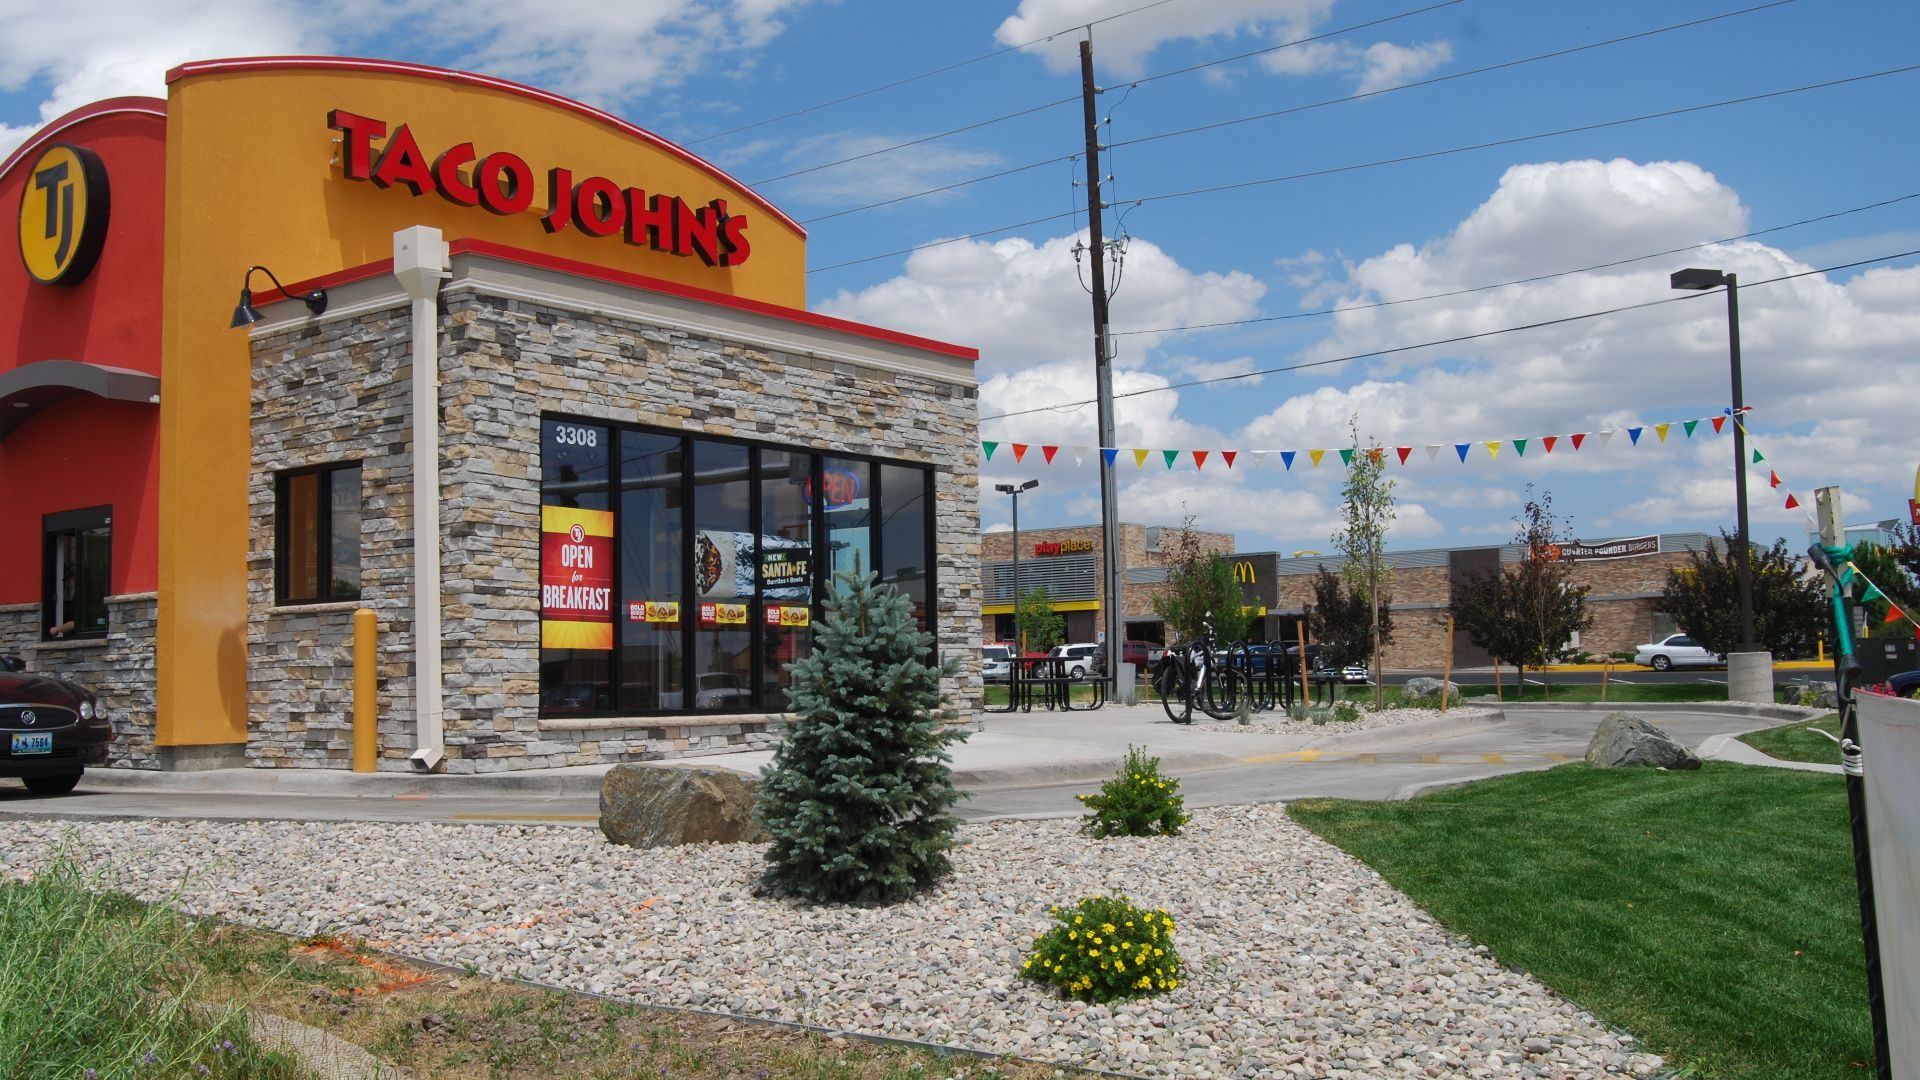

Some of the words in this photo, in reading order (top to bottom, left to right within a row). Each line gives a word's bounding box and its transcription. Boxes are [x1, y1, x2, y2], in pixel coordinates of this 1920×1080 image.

[327, 109, 534, 216] TACO
[540, 168, 751, 268] JOHN'S
[556, 425, 597, 447] 3308
[561, 544, 593, 569] OPEN
[571, 570, 583, 583] for
[761, 562, 793, 578] SANTA
[796, 560, 807, 575] FE
[543, 584, 611, 611] BREAKFAST
